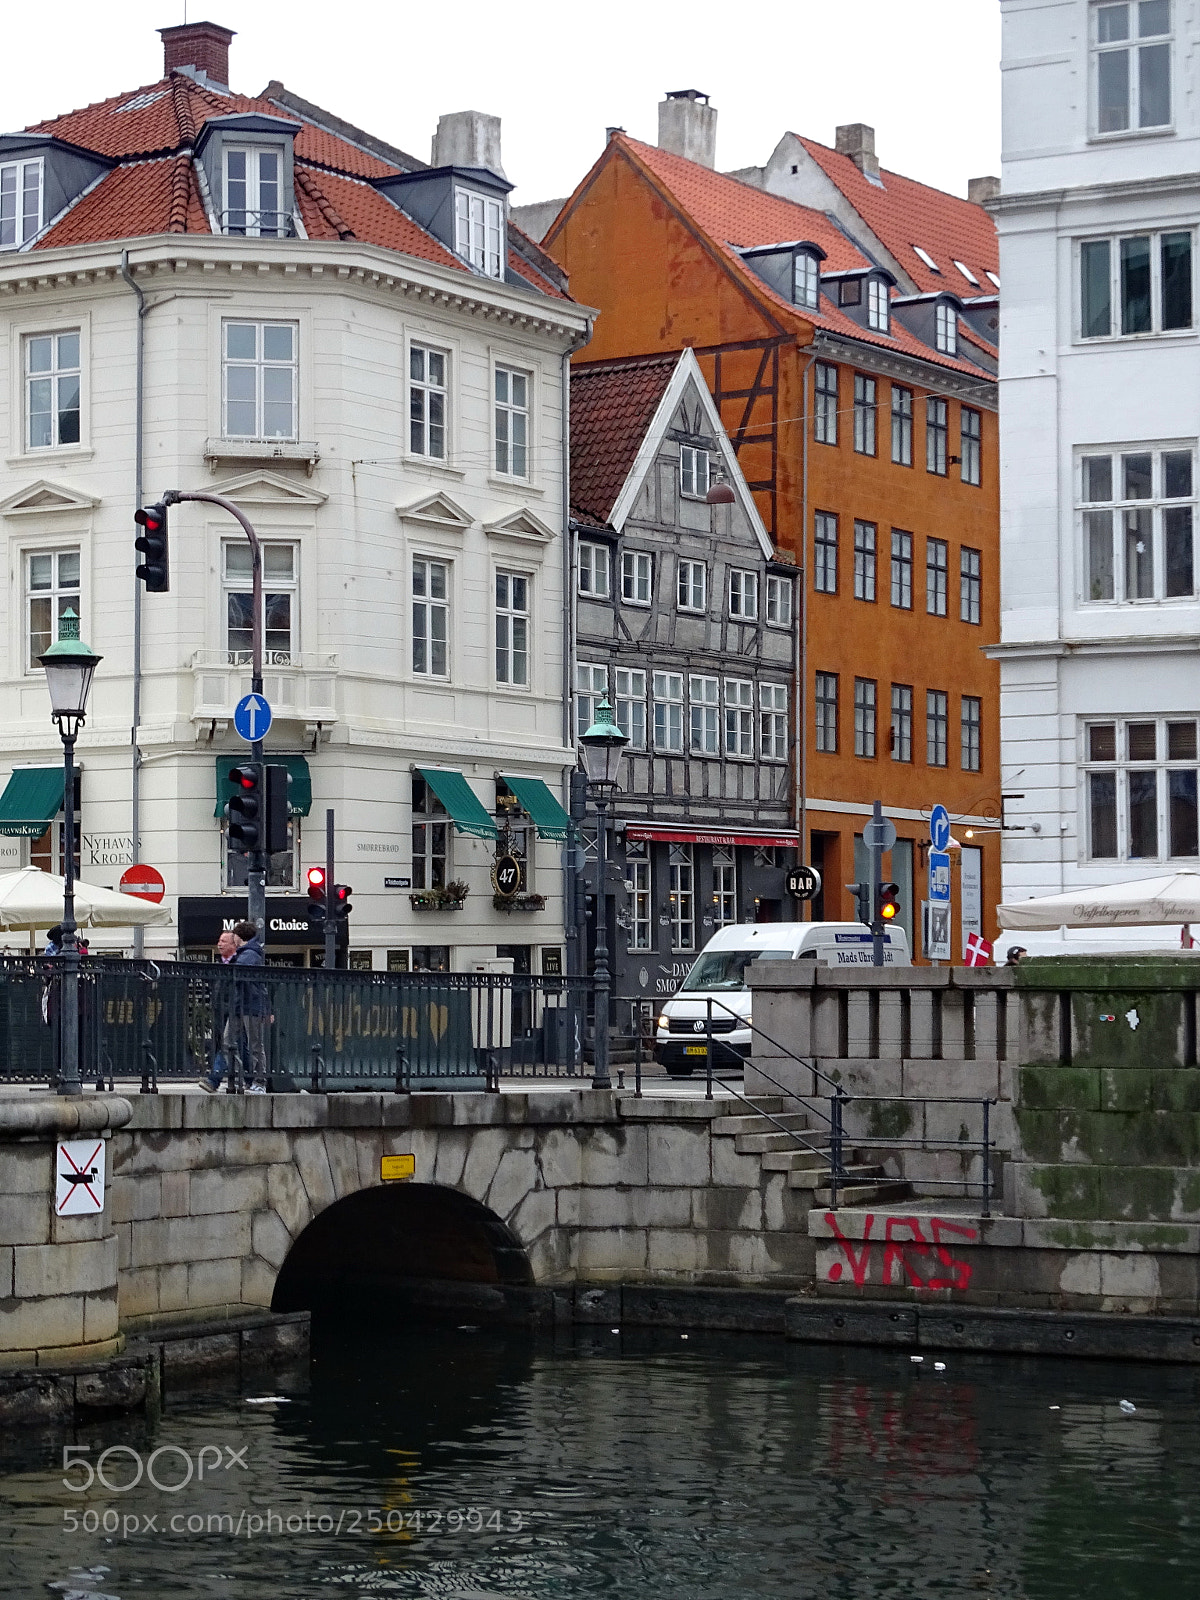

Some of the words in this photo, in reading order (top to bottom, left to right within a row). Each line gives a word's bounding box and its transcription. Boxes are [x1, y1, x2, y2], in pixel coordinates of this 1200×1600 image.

[357, 843, 399, 853] SMØRREBRØD
[90, 850, 133, 865] KROEN
[499, 868, 515, 883] 47
[790, 877, 813, 890] BAR
[1073, 903, 1140, 921] Vaffelbageren
[269, 918, 309, 931] Choice
[837, 951, 858, 963] Mads
